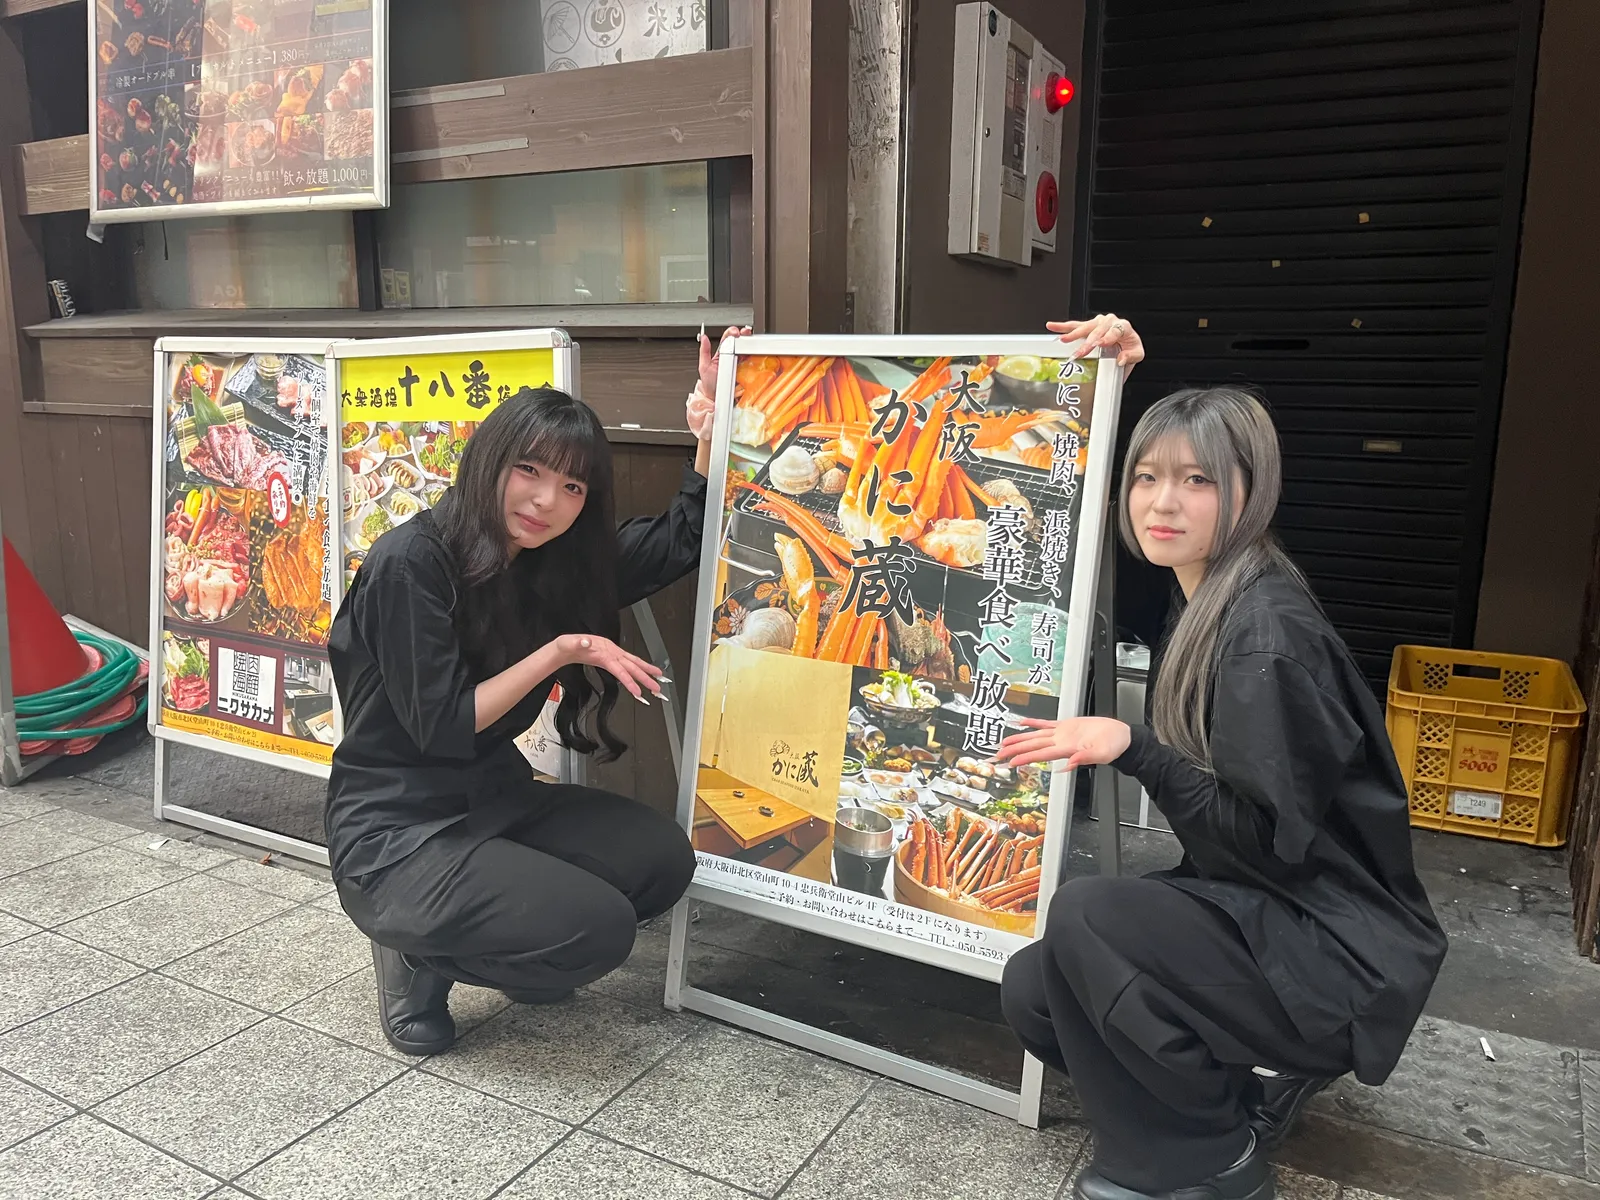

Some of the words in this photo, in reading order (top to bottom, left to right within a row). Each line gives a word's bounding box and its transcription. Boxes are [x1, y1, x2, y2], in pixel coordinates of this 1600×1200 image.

[283, 168, 329, 187] 飲み放題
[341, 387, 397, 409] 大衆酒場
[398, 359, 494, 410] 十八番
[938, 369, 986, 465] 大阪
[838, 389, 929, 628] かに蔵
[962, 504, 1028, 757] 豪華食べ放題
[217, 696, 275, 723] ニクサカナ
[524, 735, 547, 754] 十八番
[772, 750, 819, 788] かに蔵
